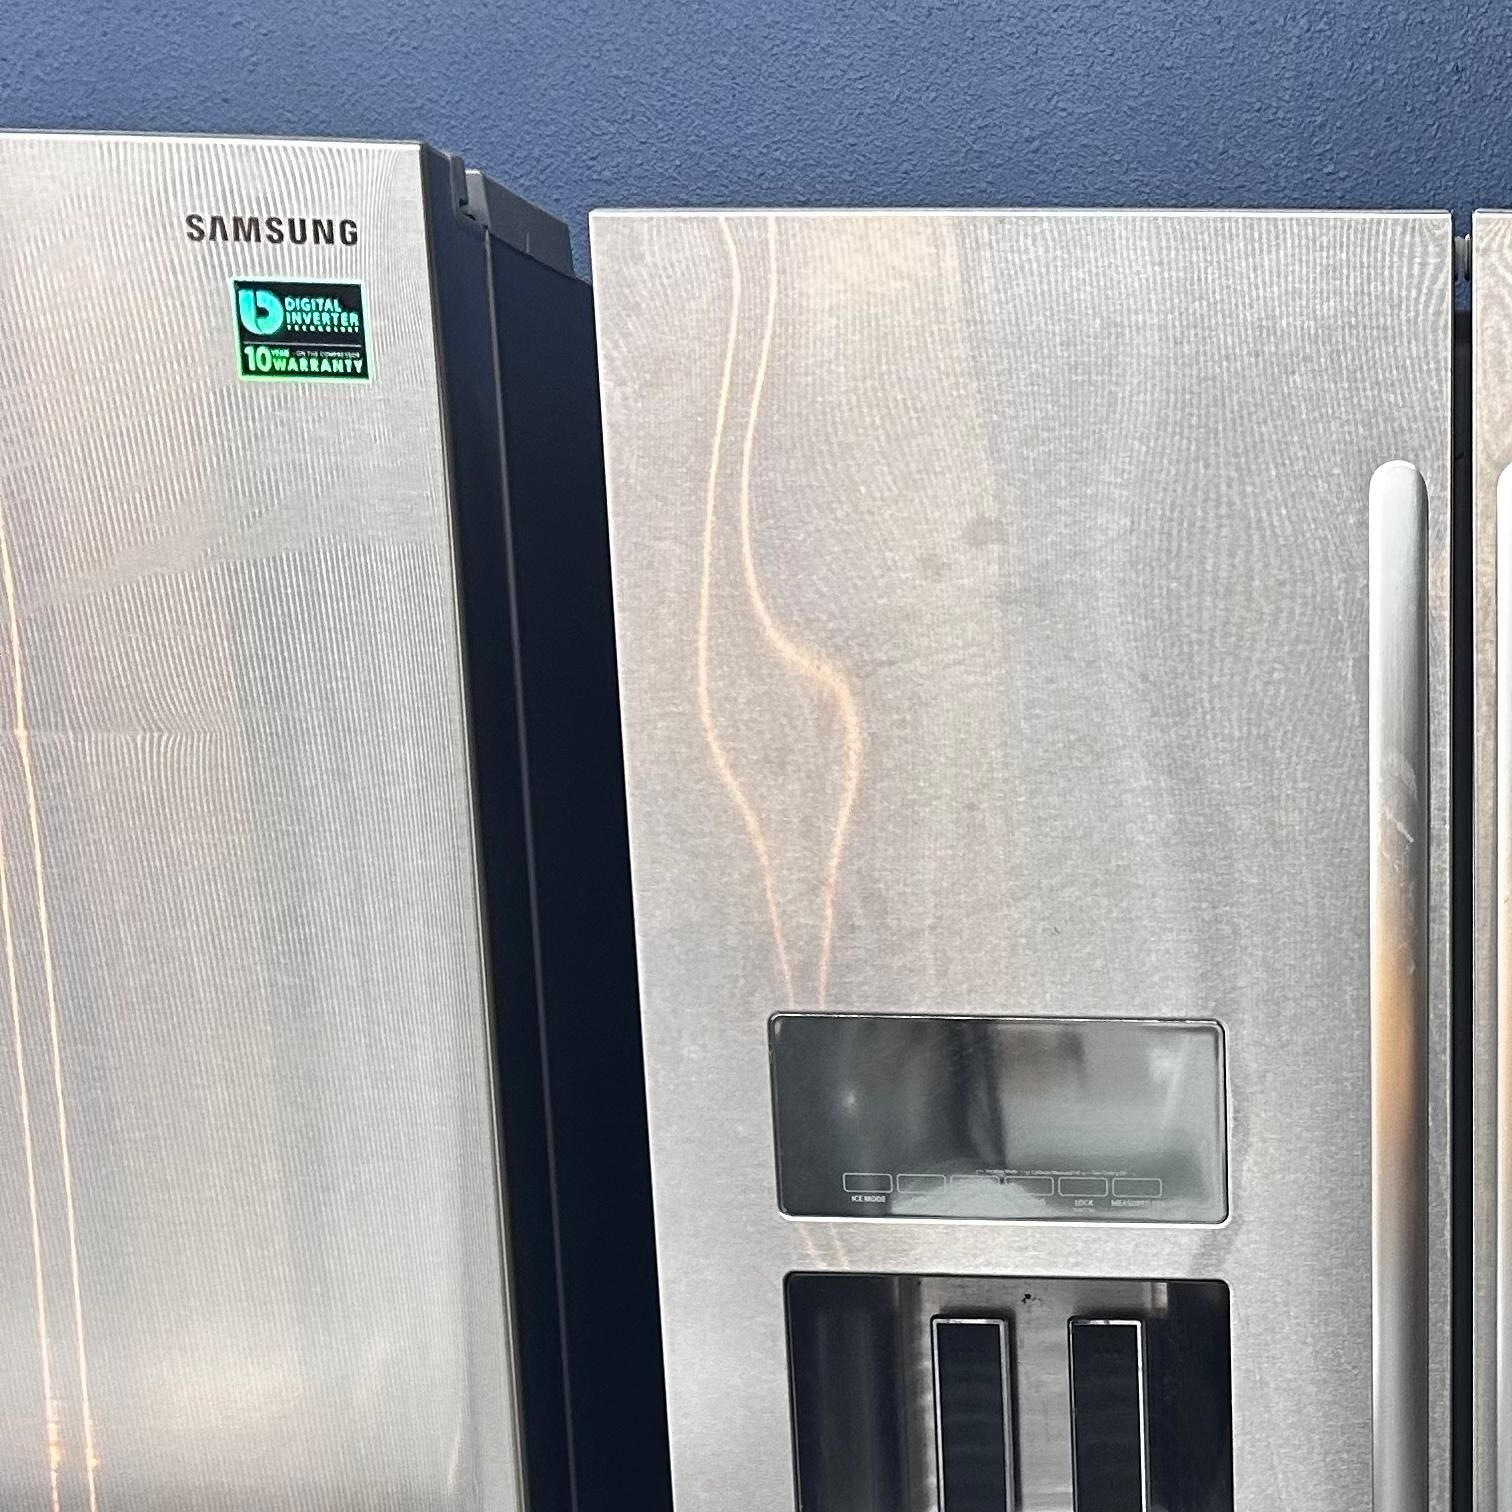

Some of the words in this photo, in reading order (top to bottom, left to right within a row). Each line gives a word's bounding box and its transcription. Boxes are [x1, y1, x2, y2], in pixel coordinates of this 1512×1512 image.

[185, 214, 359, 246] SAMSUNG
[284, 297, 342, 313] DIGITAL
[285, 311, 360, 327] INVERTER
[244, 346, 272, 372] 10
[272, 357, 363, 374] WARRANTY
